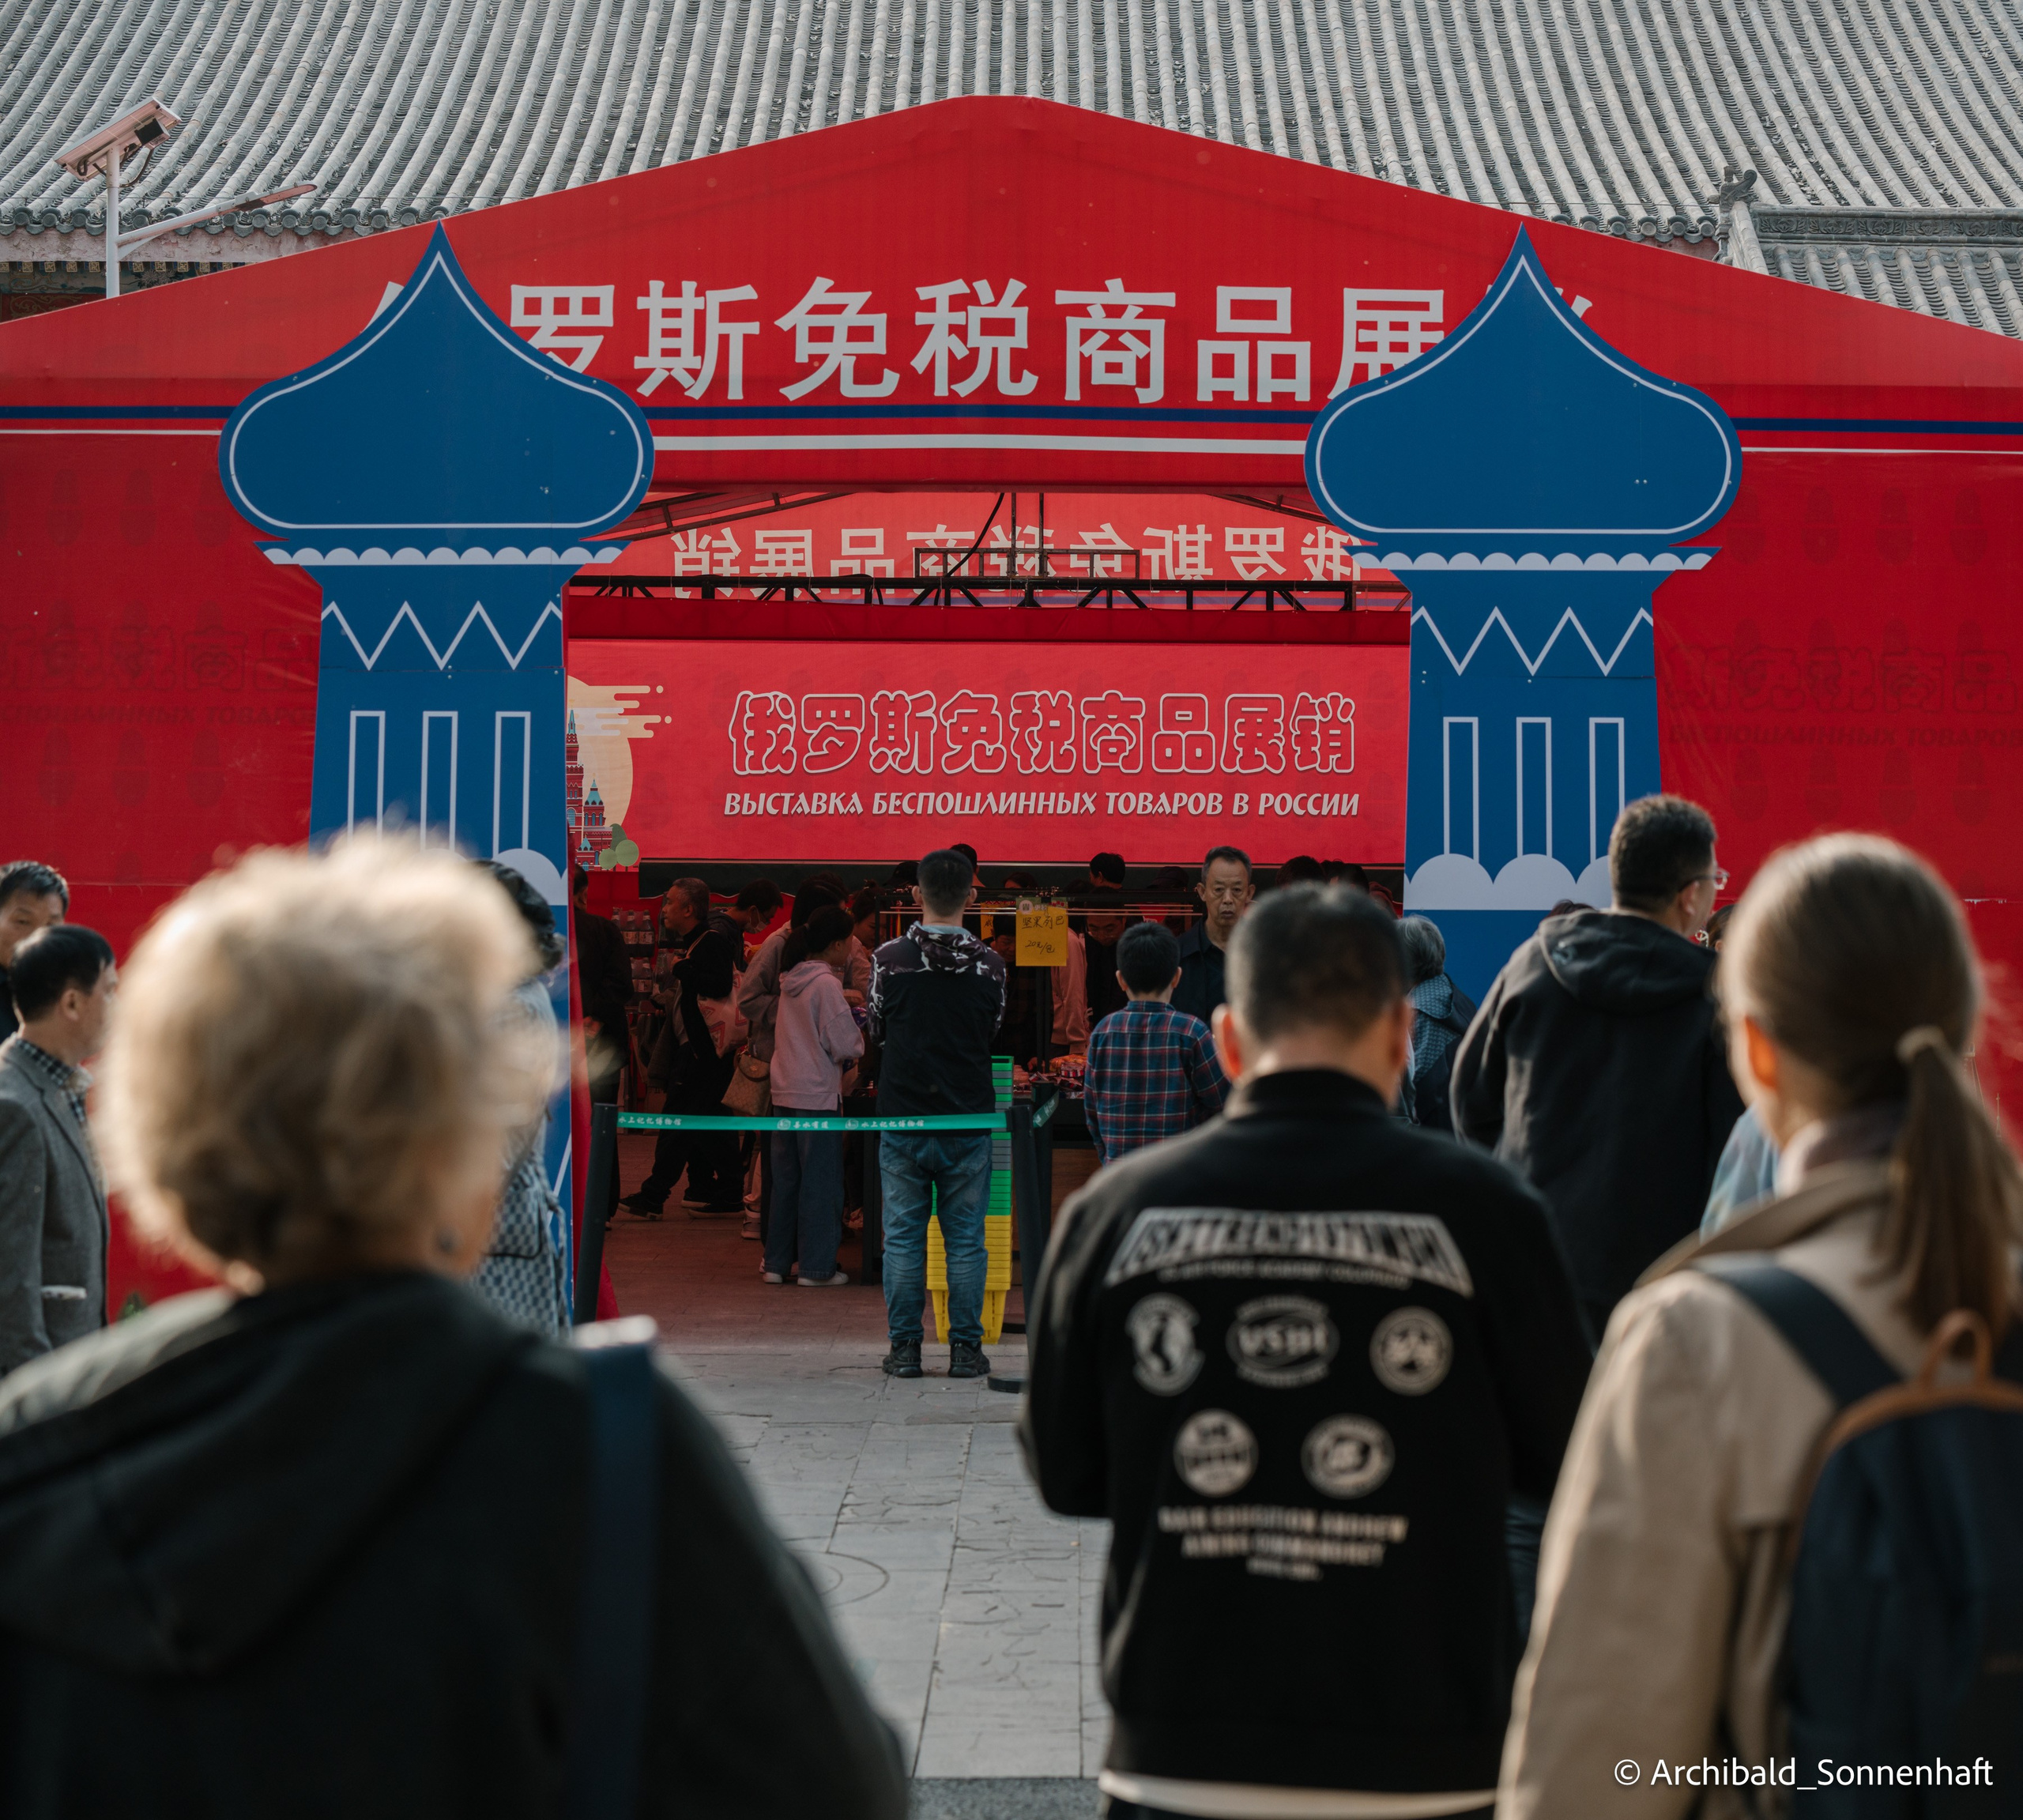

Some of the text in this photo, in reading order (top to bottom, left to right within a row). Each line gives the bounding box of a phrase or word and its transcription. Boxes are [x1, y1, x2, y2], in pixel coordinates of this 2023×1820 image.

[360, 274, 1593, 404] 罗斯免税商品展
[729, 690, 1356, 775] 俄罗斯免税商品展销
[724, 792, 1359, 816] ВЫСТАВКА БЕСПОШЛИННЫХ ТОВАРОВ В РОССИИ
[1022, 915, 1064, 929] 坚果列巴
[618, 1116, 683, 1127] 水上记忆博物馆
[861, 1119, 925, 1129] 水上记忆博物馆
